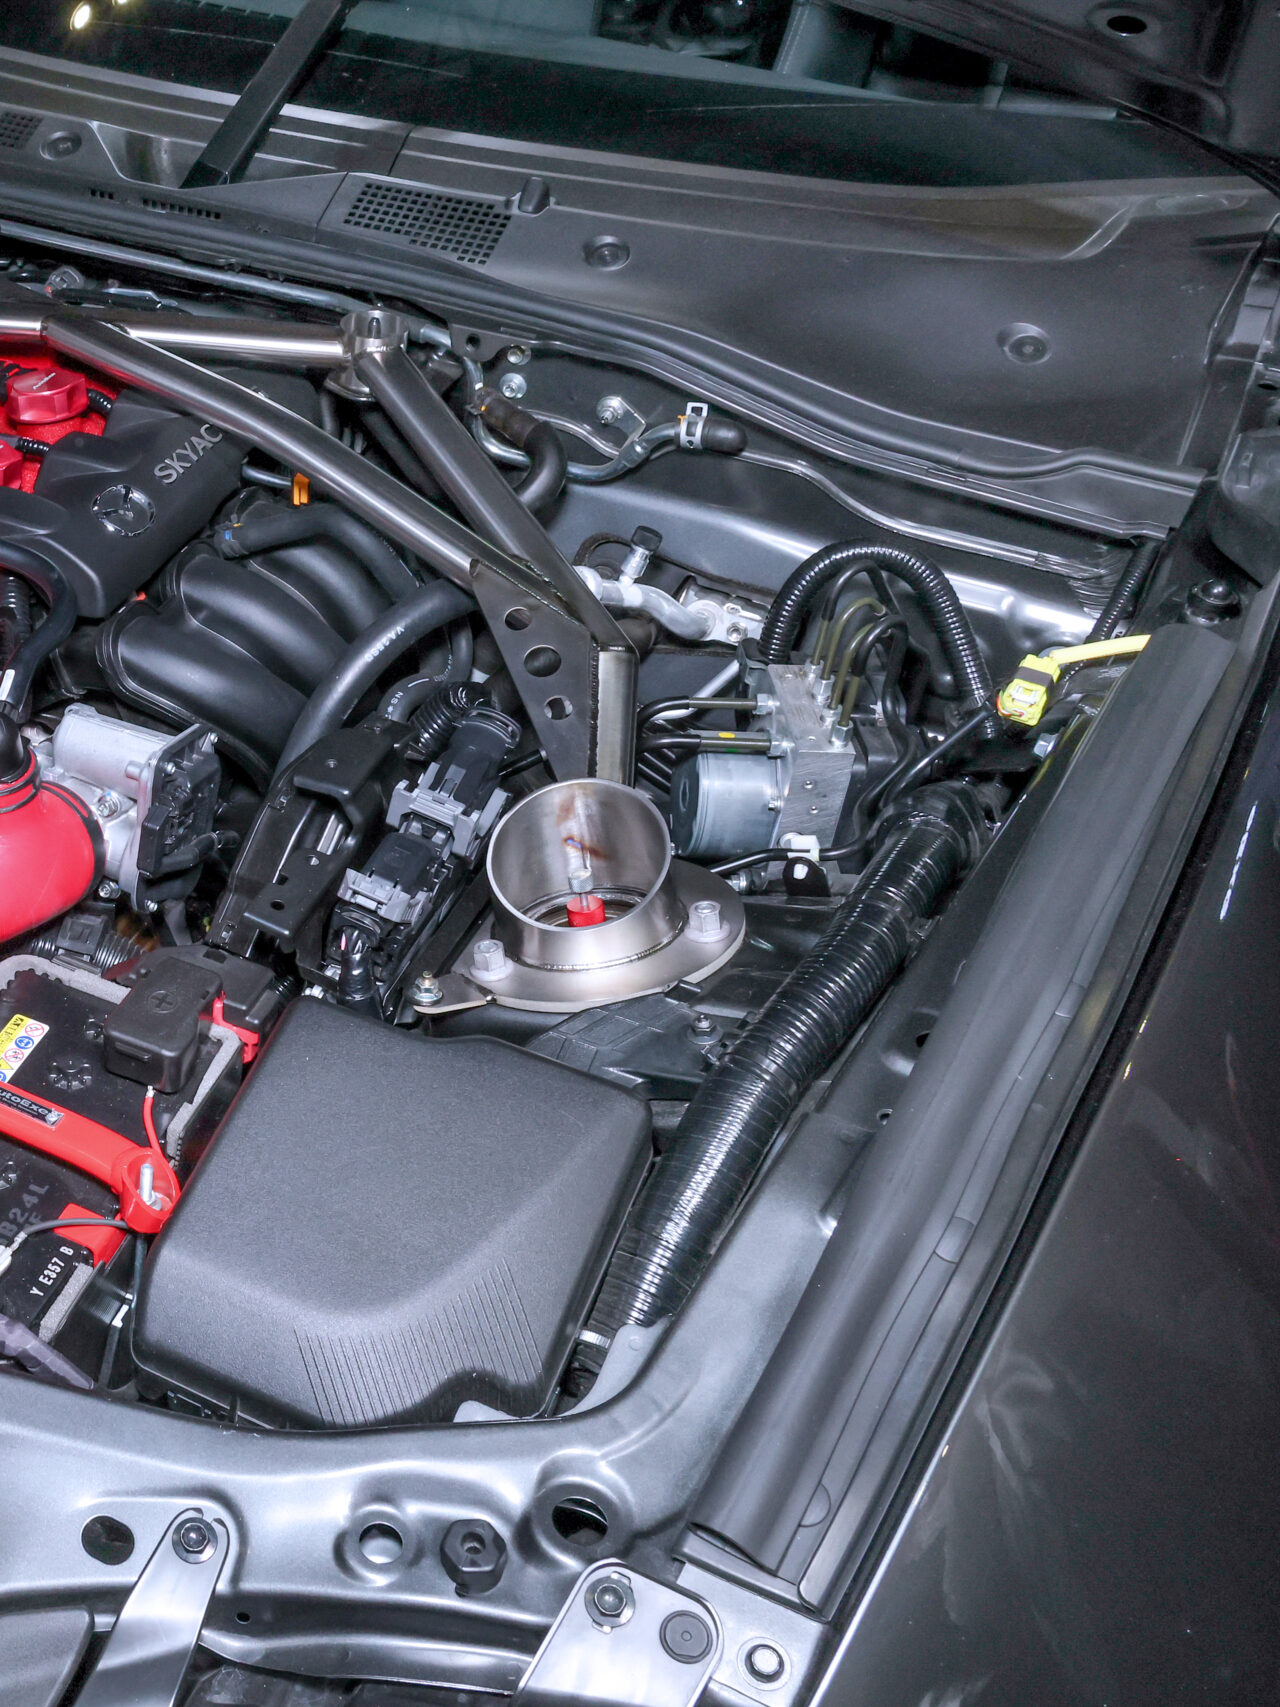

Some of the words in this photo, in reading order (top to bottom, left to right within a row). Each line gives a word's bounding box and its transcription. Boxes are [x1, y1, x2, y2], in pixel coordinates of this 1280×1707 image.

[153, 423, 223, 485] SKYAC
[29, 1286, 44, 1297] Y
[38, 1256, 65, 1286] E357
[59, 1245, 74, 1256] B
